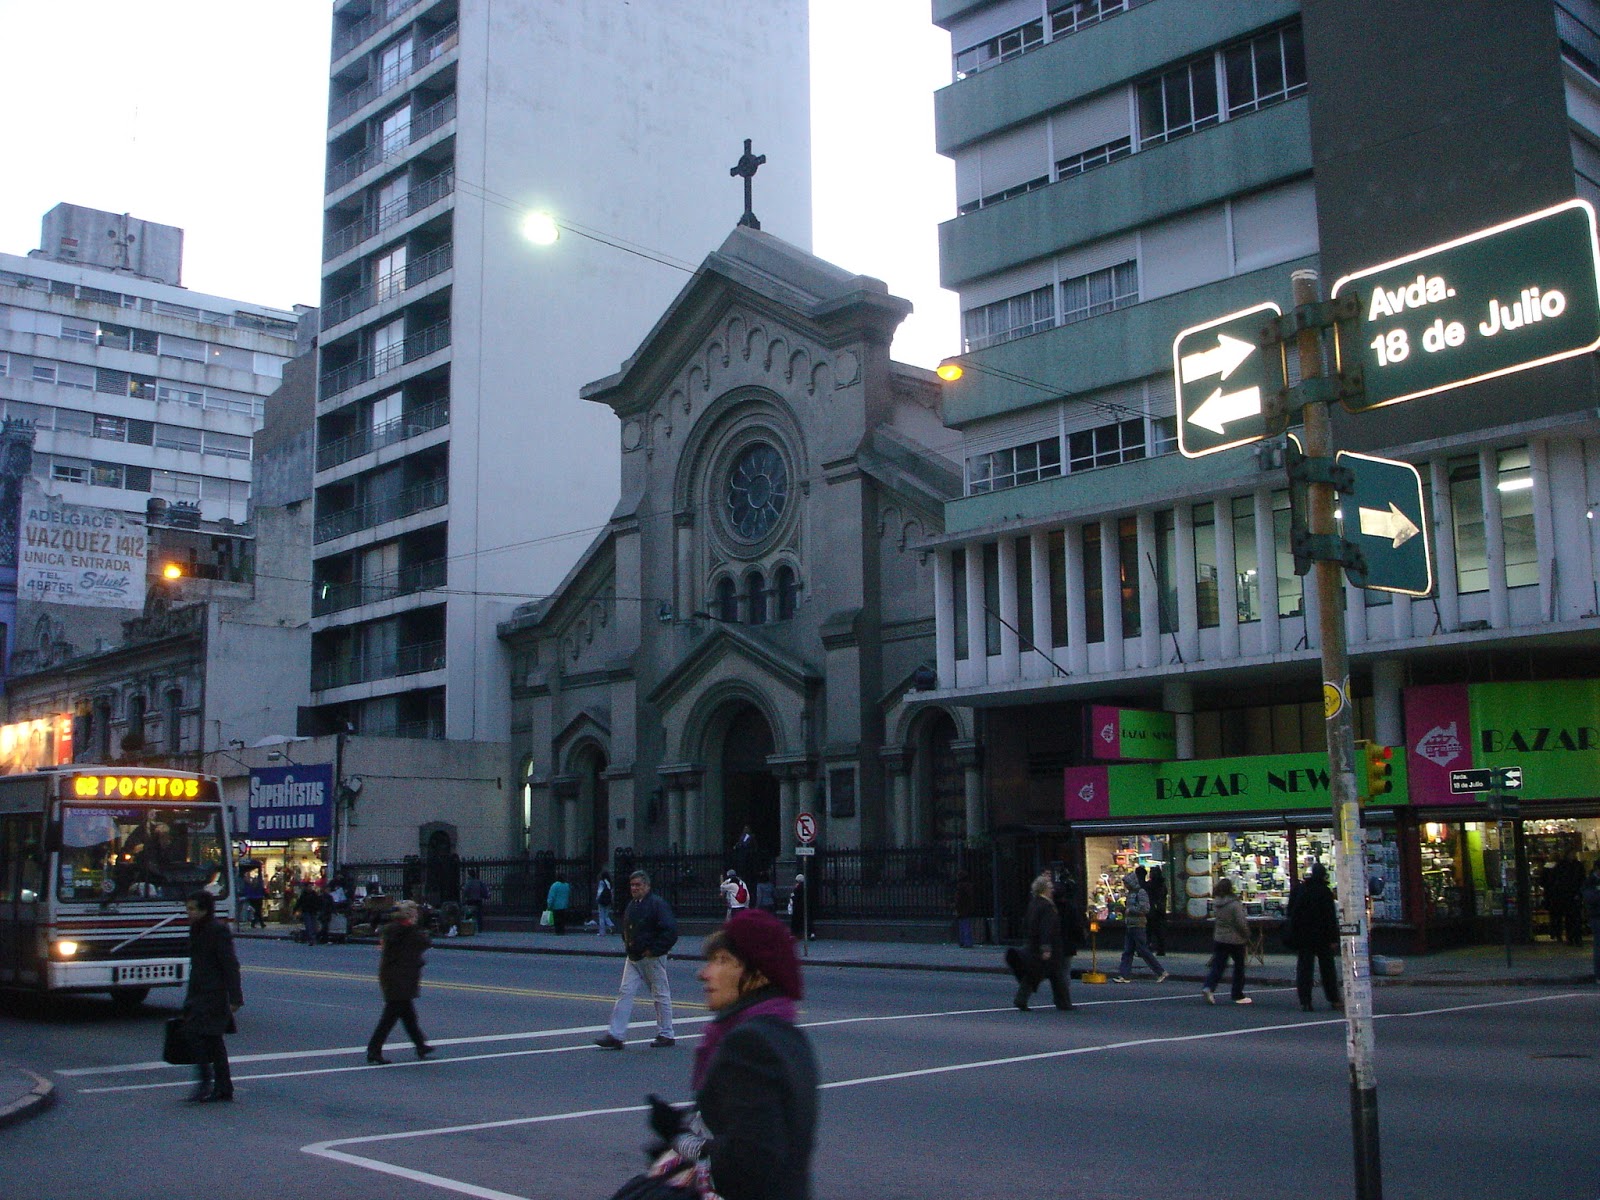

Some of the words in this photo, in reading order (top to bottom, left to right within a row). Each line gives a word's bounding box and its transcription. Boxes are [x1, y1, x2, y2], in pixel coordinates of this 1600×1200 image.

[1368, 274, 1456, 322] Avda.
[1370, 328, 1410, 367] 18
[1422, 318, 1466, 353] de
[1478, 286, 1566, 337] Julio
[29, 509, 114, 529] ADELGACE
[26, 525, 111, 553] VAZQUEZ
[116, 535, 144, 557] 1412
[24, 551, 65, 566] UNICA
[71, 555, 131, 572] ENTRADA
[38, 571, 61, 580] TEL
[1481, 726, 1600, 753] BAZAR
[105, 777, 198, 797] POCITOS
[1156, 772, 1249, 800] BAZAR
[257, 813, 315, 830] COTILLON
